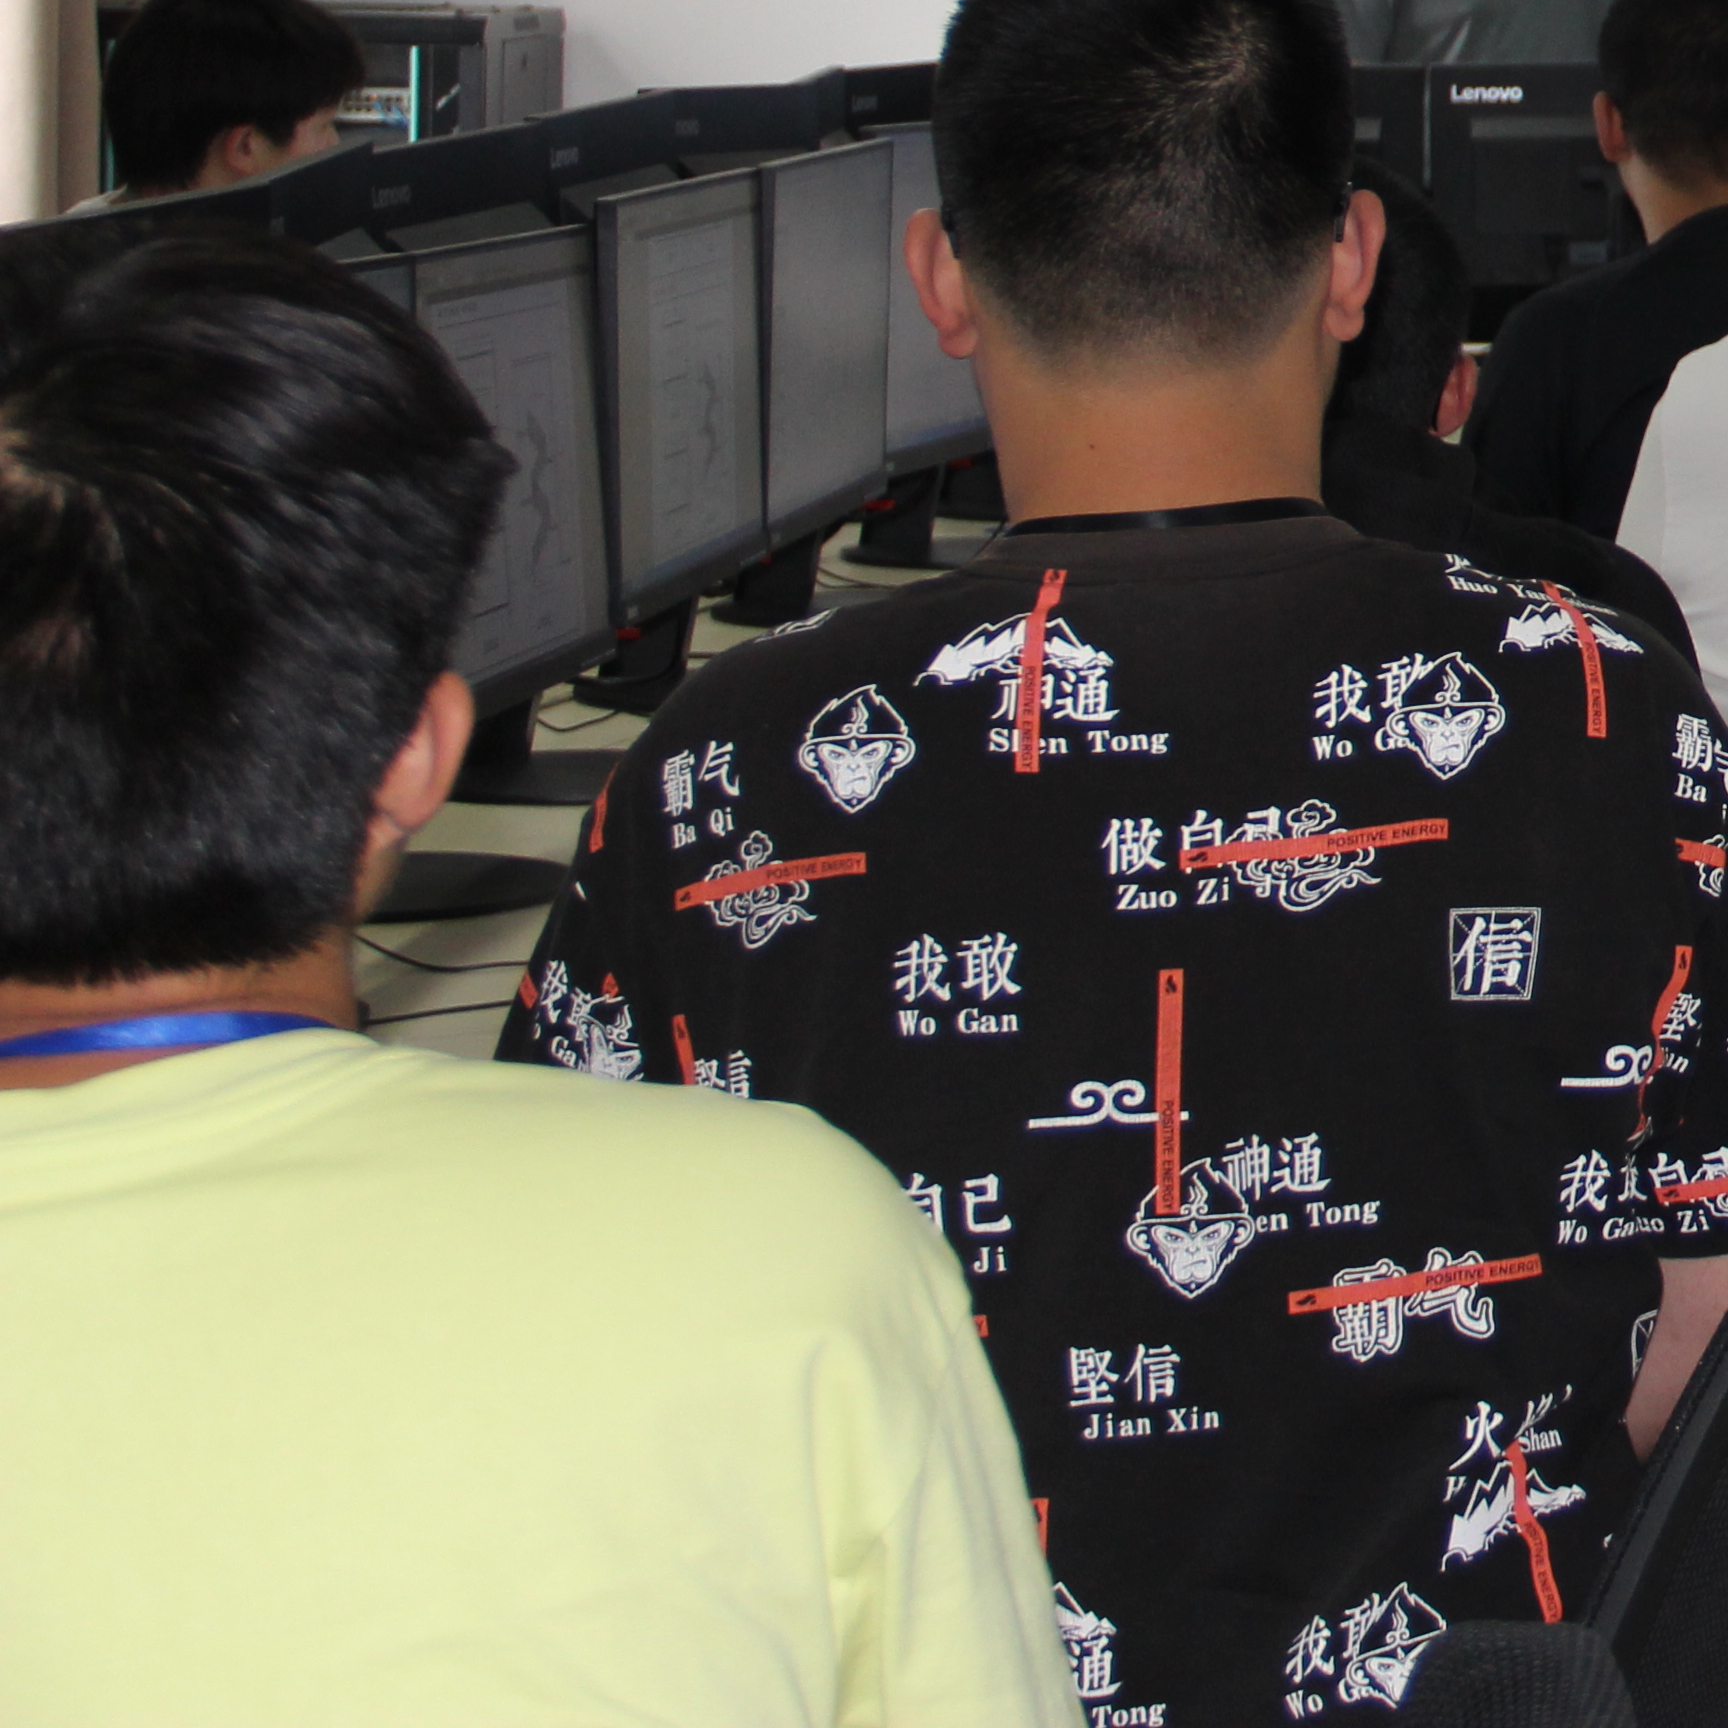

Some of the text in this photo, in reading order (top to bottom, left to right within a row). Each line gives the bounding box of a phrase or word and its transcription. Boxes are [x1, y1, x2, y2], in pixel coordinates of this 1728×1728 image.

[1450, 83, 1524, 104] Lenovo
[1087, 729, 1169, 754] Tong
[1313, 734, 1353, 761] Wo
[663, 741, 740, 817] 霸气
[1674, 773, 1708, 803] Ba
[672, 807, 735, 849] Ba Qi
[1327, 823, 1446, 848] POSITIVE ENERGY
[1116, 883, 1178, 910] Zuo
[1196, 876, 1229, 905] Zi
[893, 932, 1022, 1003] 我敢
[1452, 916, 1533, 994] 信
[898, 1008, 1019, 1036] Wo Gan
[1162, 1100, 1176, 1210] POSITIVE ENERGY
[1222, 1132, 1332, 1201] 神通
[1306, 1200, 1380, 1226] Tong
[1557, 1220, 1588, 1244] Wo
[1677, 1208, 1711, 1233] Zi
[973, 1246, 1007, 1272] Ji
[1425, 1269, 1485, 1286] POSITIVE
[1083, 1406, 1220, 1440] Jian Xin
[1518, 1428, 1562, 1453] Shan
[1092, 1703, 1166, 1728] Tong
[1286, 1689, 1324, 1719] Wo
